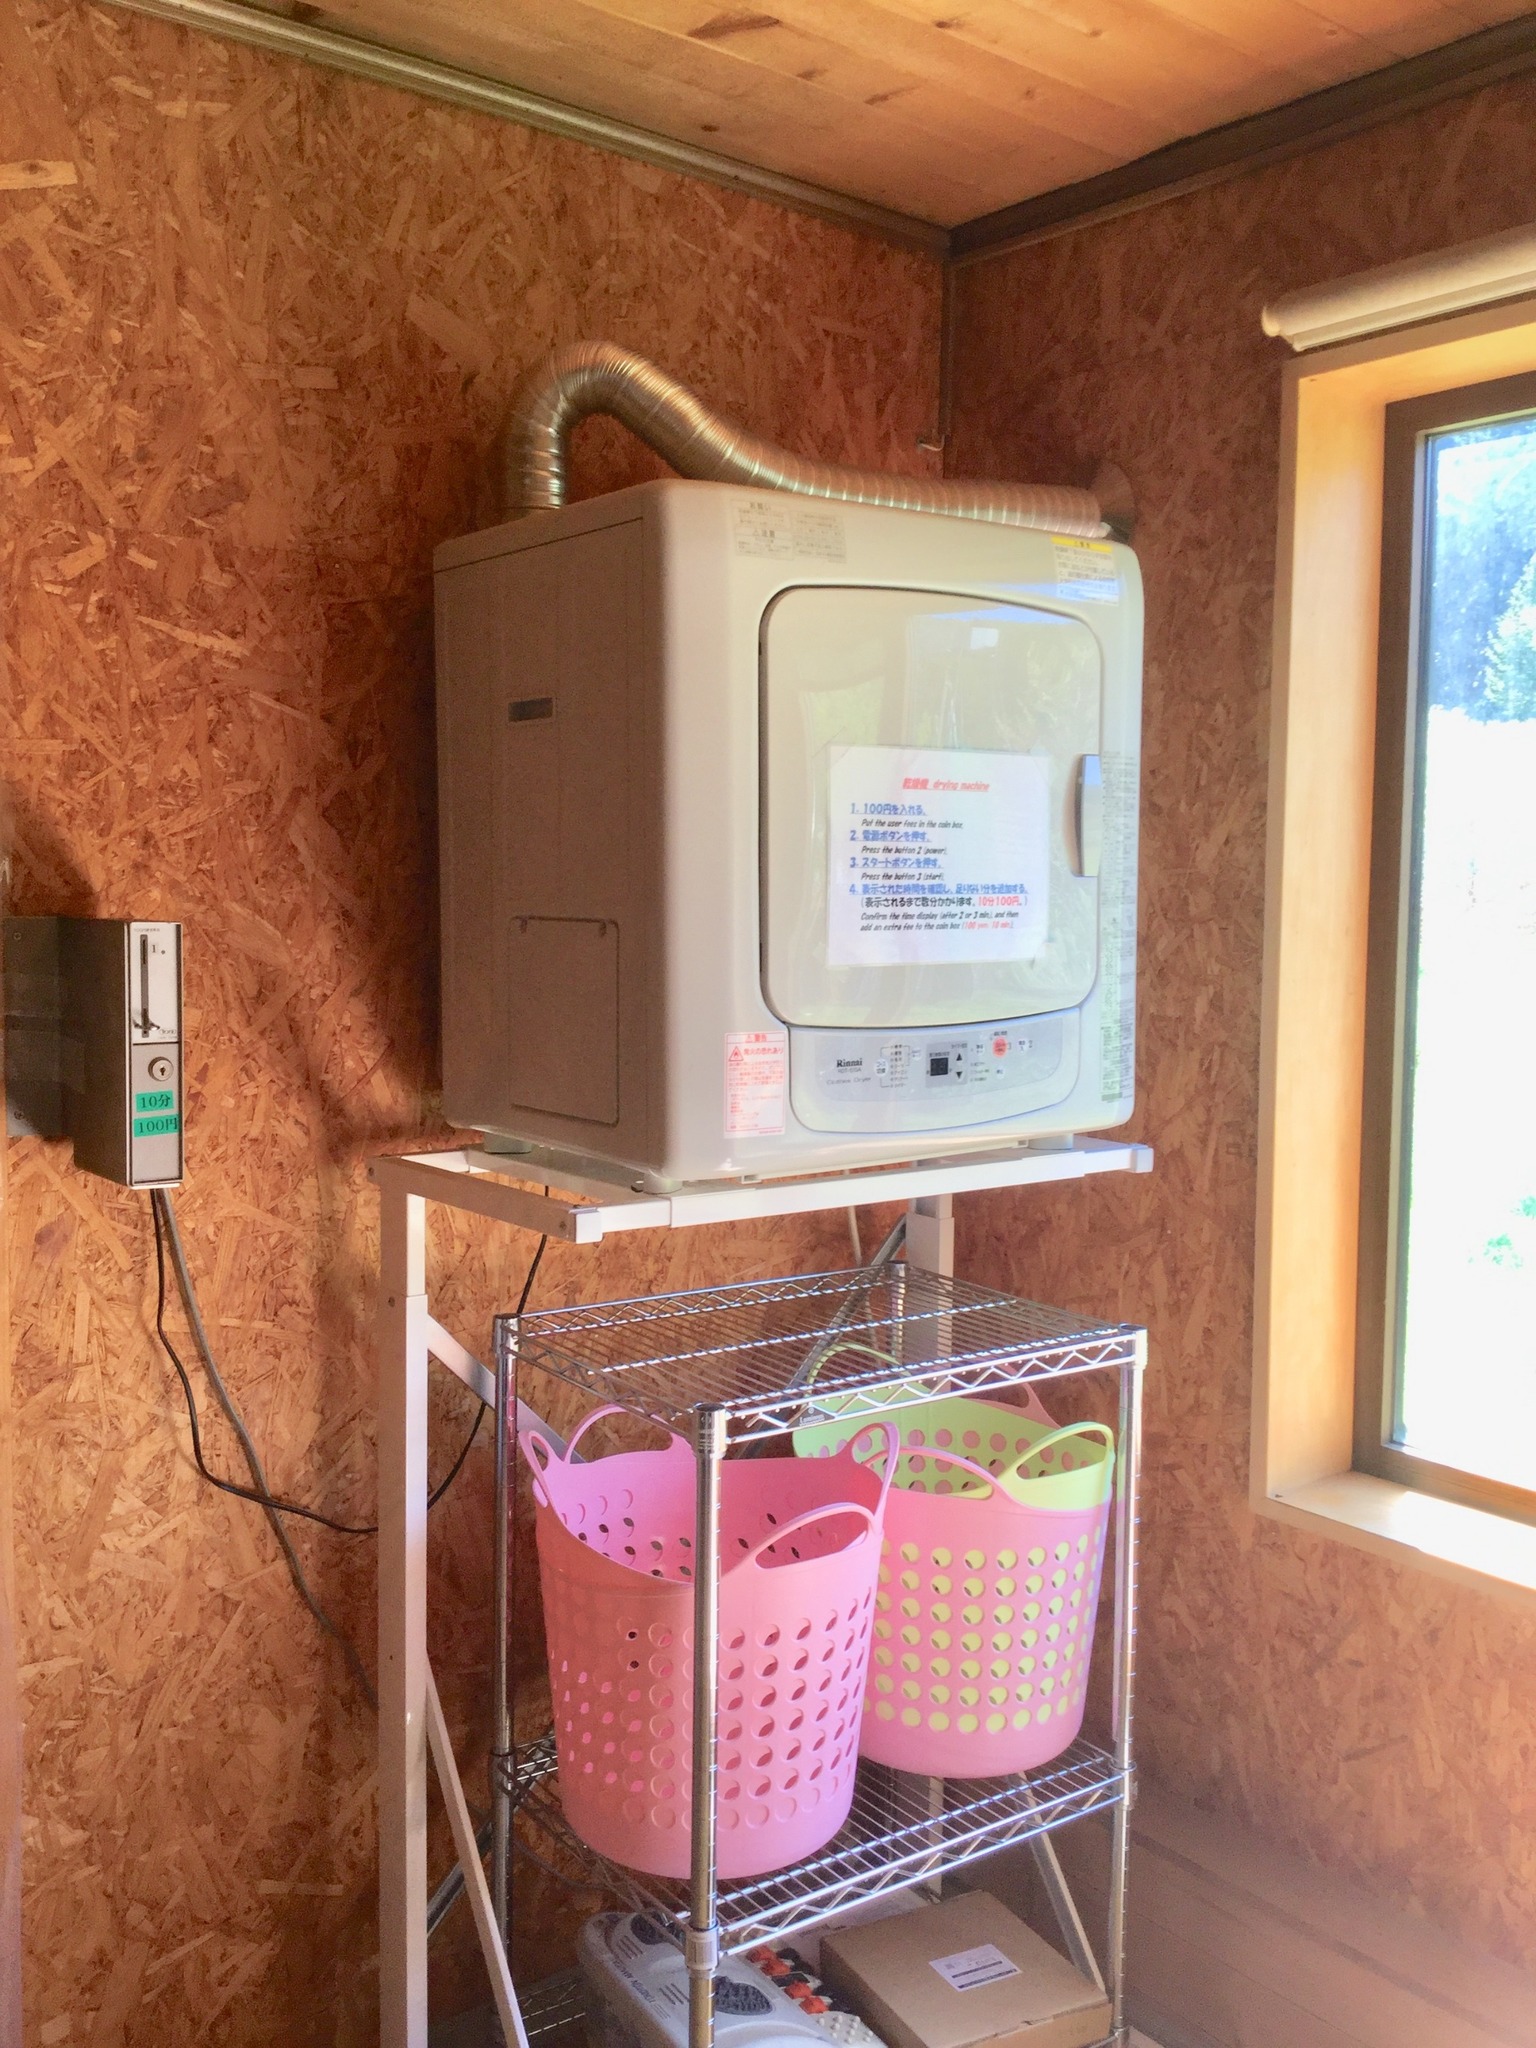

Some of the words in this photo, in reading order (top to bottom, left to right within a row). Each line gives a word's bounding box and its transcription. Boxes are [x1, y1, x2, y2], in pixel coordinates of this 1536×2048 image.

[933, 779, 959, 790] drying
[960, 781, 990, 791] machine
[851, 803, 860, 814] 1.
[862, 819, 874, 827] Put
[875, 819, 886, 827] the
[919, 820, 925, 828] in
[926, 820, 936, 828] the
[938, 820, 951, 828] coin
[850, 830, 859, 841] 2.
[861, 845, 880, 854] Press
[882, 845, 893, 854] the
[895, 846, 916, 854] button
[917, 846, 922, 854] 2
[850, 857, 859, 868] 3.
[861, 872, 880, 880] Press
[882, 872, 893, 880] the
[917, 873, 922, 881] 3
[861, 912, 887, 920] Confirm
[889, 912, 900, 920] the
[902, 912, 915, 920] time
[916, 911, 938, 920] display
[959, 911, 964, 919] 2
[973, 911, 978, 919] 3
[860, 923, 873, 931] add
[883, 923, 901, 931] extra
[903, 922, 914, 930] fee
[915, 922, 922, 930] to
[924, 922, 934, 930] the
[935, 922, 948, 930] coin
[950, 922, 960, 930] box
[836, 1058, 863, 1067] Rinnai
[141, 1094, 170, 1109] 10分
[139, 1117, 178, 1133] 100円
